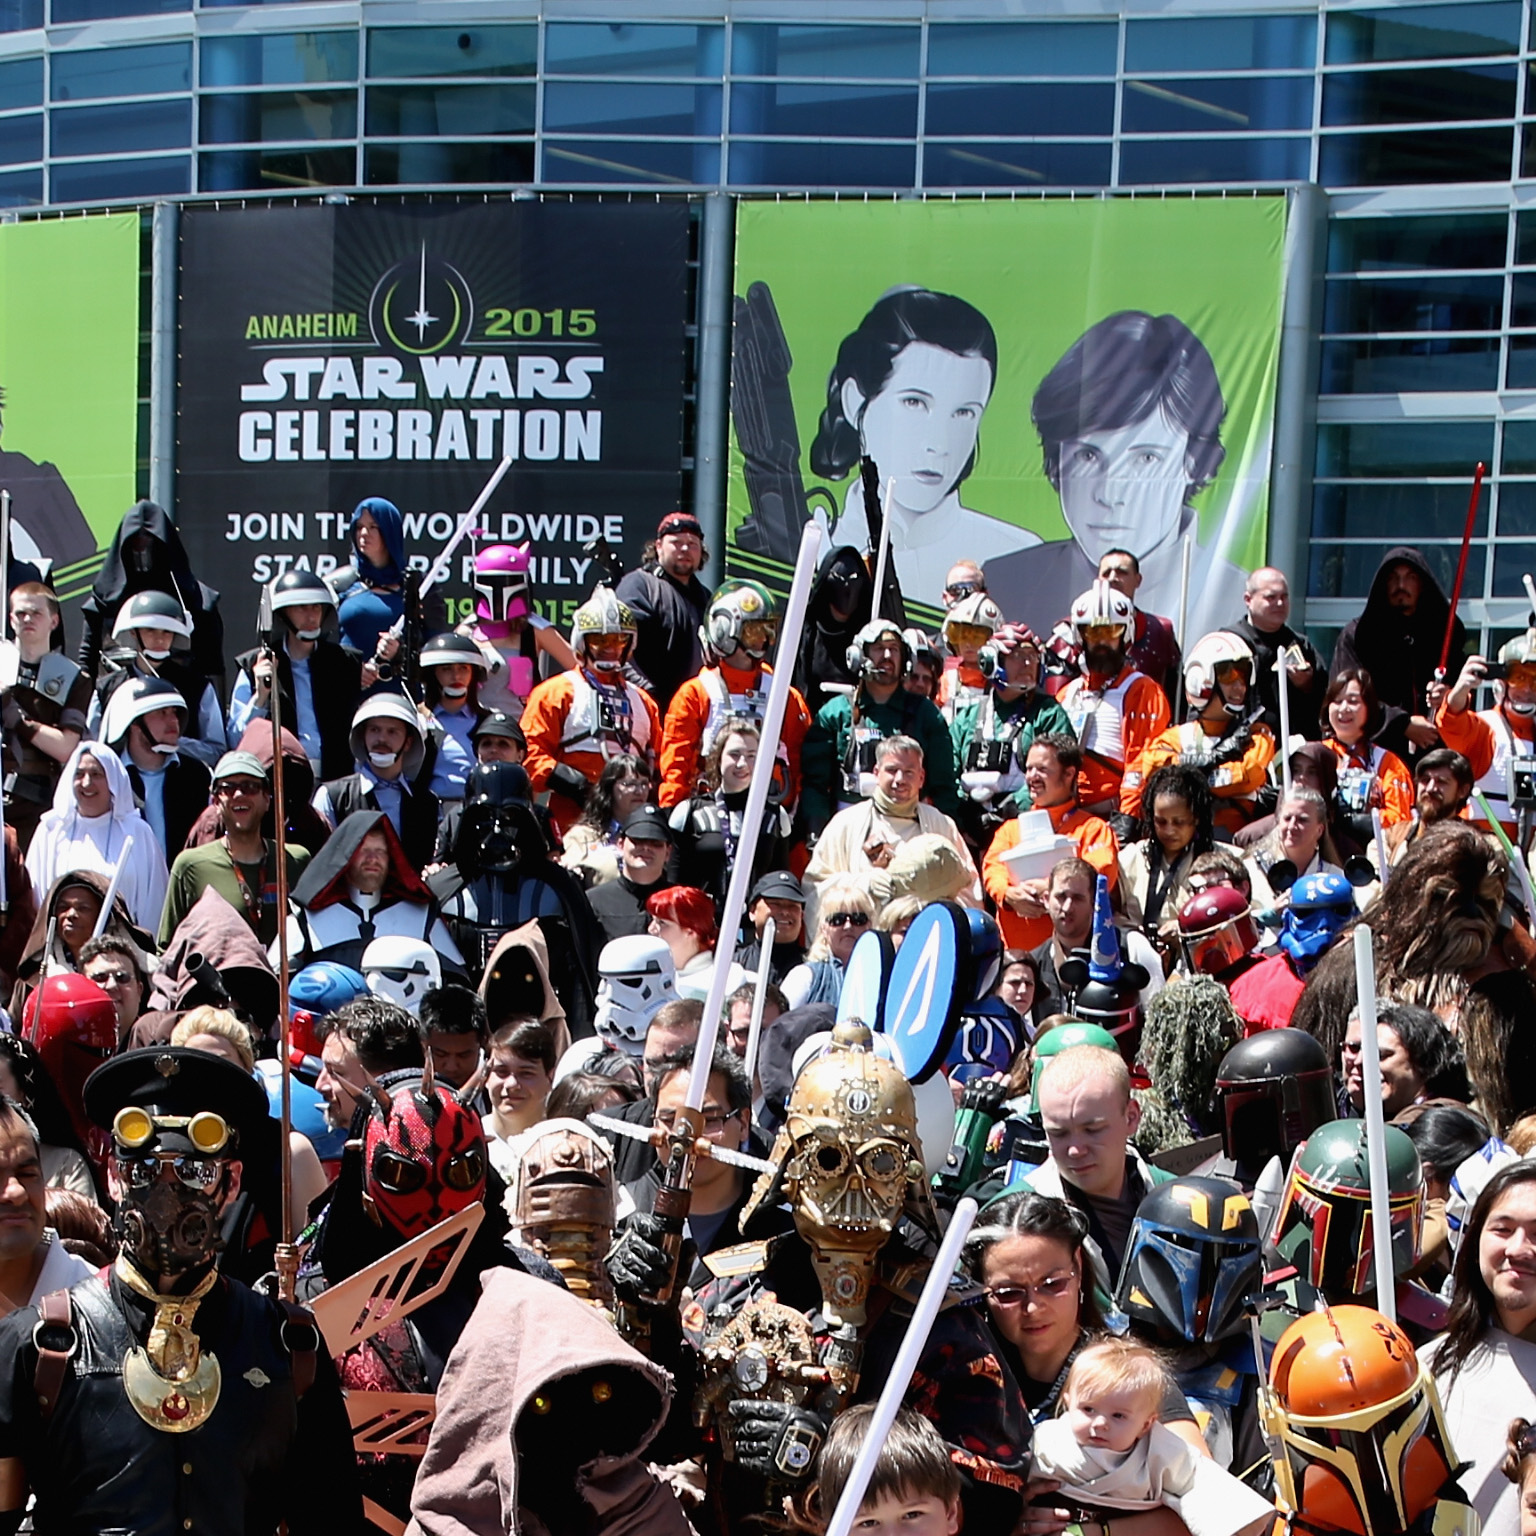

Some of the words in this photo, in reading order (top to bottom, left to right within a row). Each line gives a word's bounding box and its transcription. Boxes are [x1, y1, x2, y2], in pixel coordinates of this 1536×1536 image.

[245, 313, 358, 339] ANAHEIM
[484, 308, 596, 336] 2015
[241, 356, 416, 401] STAR
[419, 355, 604, 399] WARS
[238, 408, 602, 462] CELEBRATION
[225, 512, 305, 541] JOIN
[315, 512, 351, 540] TH
[462, 556, 592, 585] FILY
